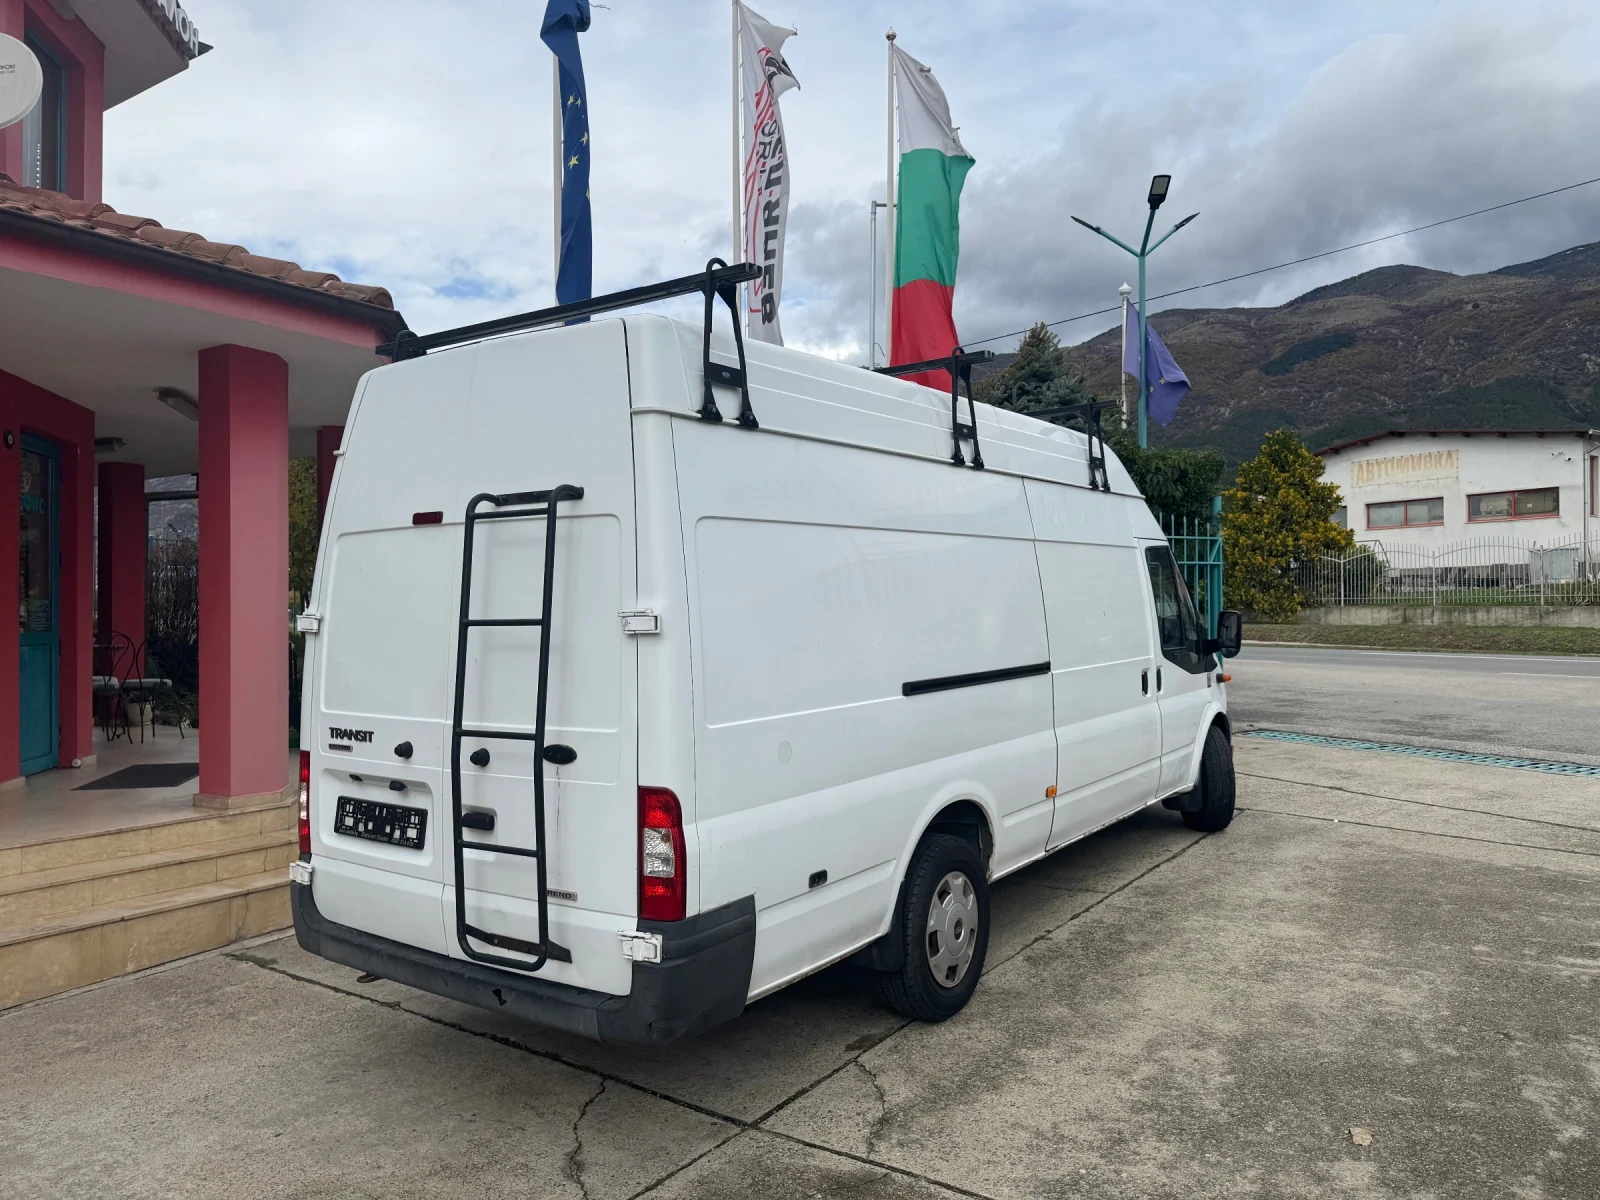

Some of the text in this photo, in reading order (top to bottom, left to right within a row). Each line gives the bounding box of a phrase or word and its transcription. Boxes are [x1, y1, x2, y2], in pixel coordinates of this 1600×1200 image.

[1356, 453, 1455, 485] АВТОМИВКА
[328, 727, 374, 743] TRANSIT
[547, 890, 572, 899] REND
